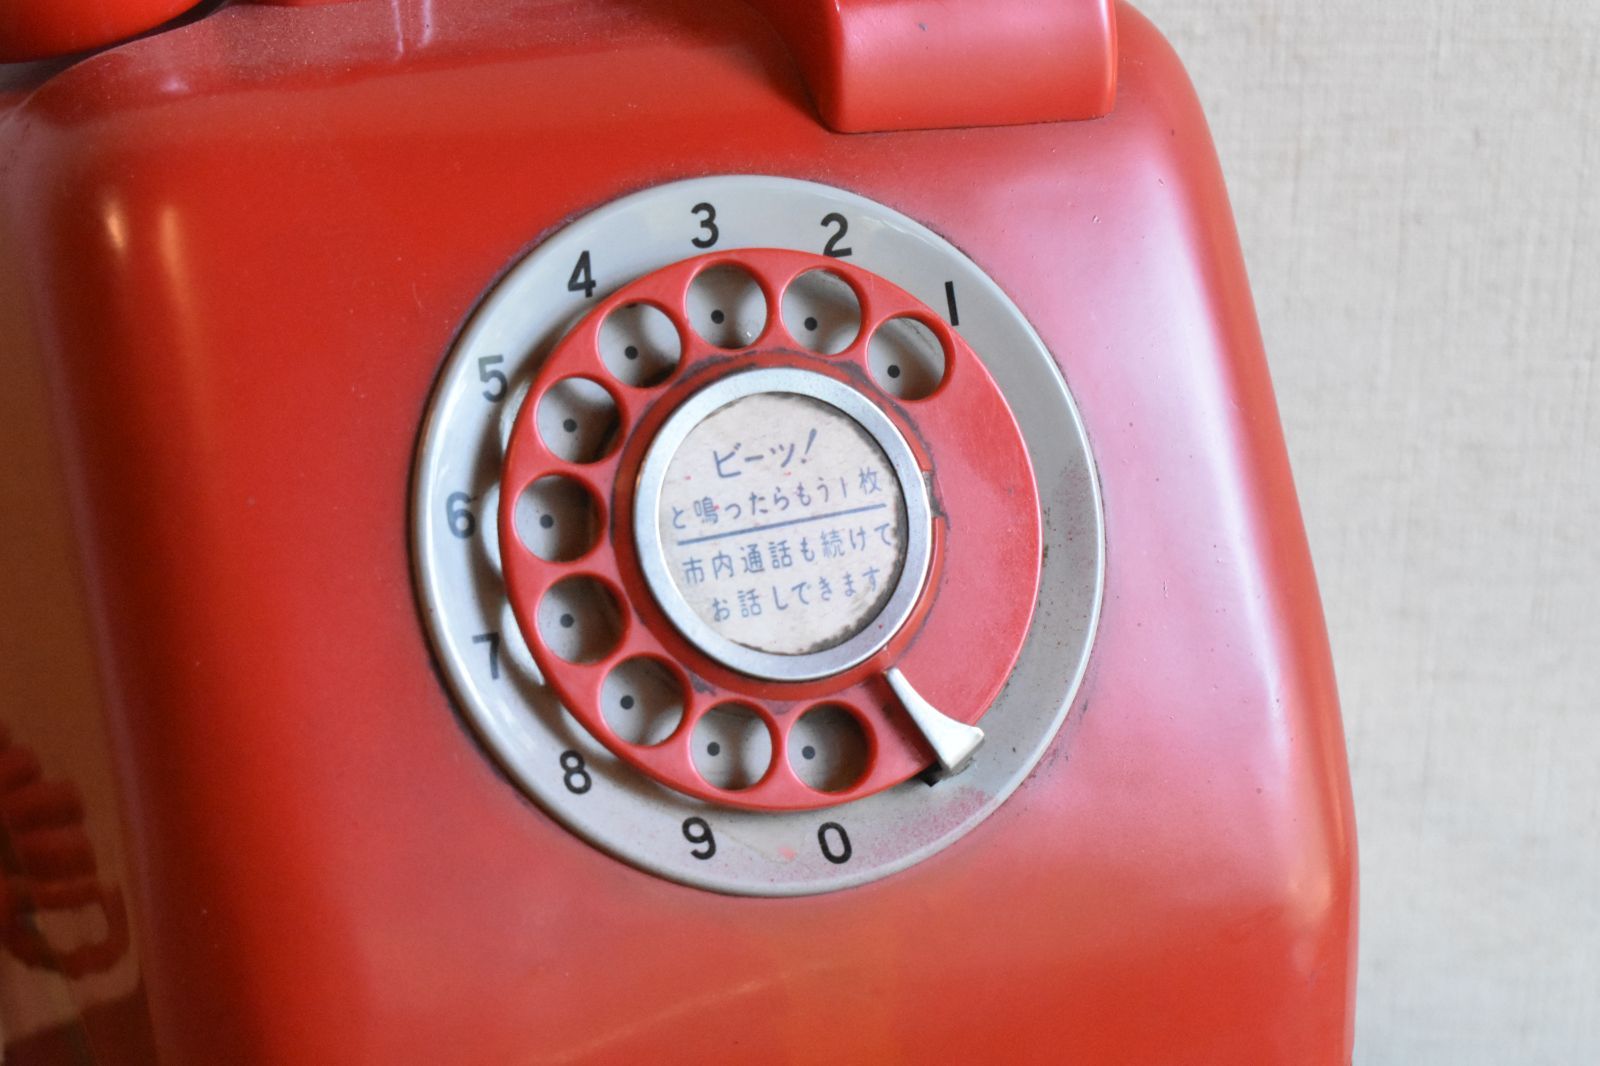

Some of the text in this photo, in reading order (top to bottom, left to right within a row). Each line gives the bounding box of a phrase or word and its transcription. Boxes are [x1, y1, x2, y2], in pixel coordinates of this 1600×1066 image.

[691, 202, 719, 249] 3
[821, 212, 852, 256] 2
[567, 250, 596, 298] 4
[945, 281, 960, 327] 1
[478, 354, 507, 402] 5
[446, 492, 475, 538] 6
[682, 522, 894, 585] 市内通話も続けて
[711, 565, 881, 622] お話しできます
[472, 633, 501, 680] 7
[560, 751, 592, 795] 8
[682, 817, 718, 860] 9
[817, 821, 852, 865] 0
